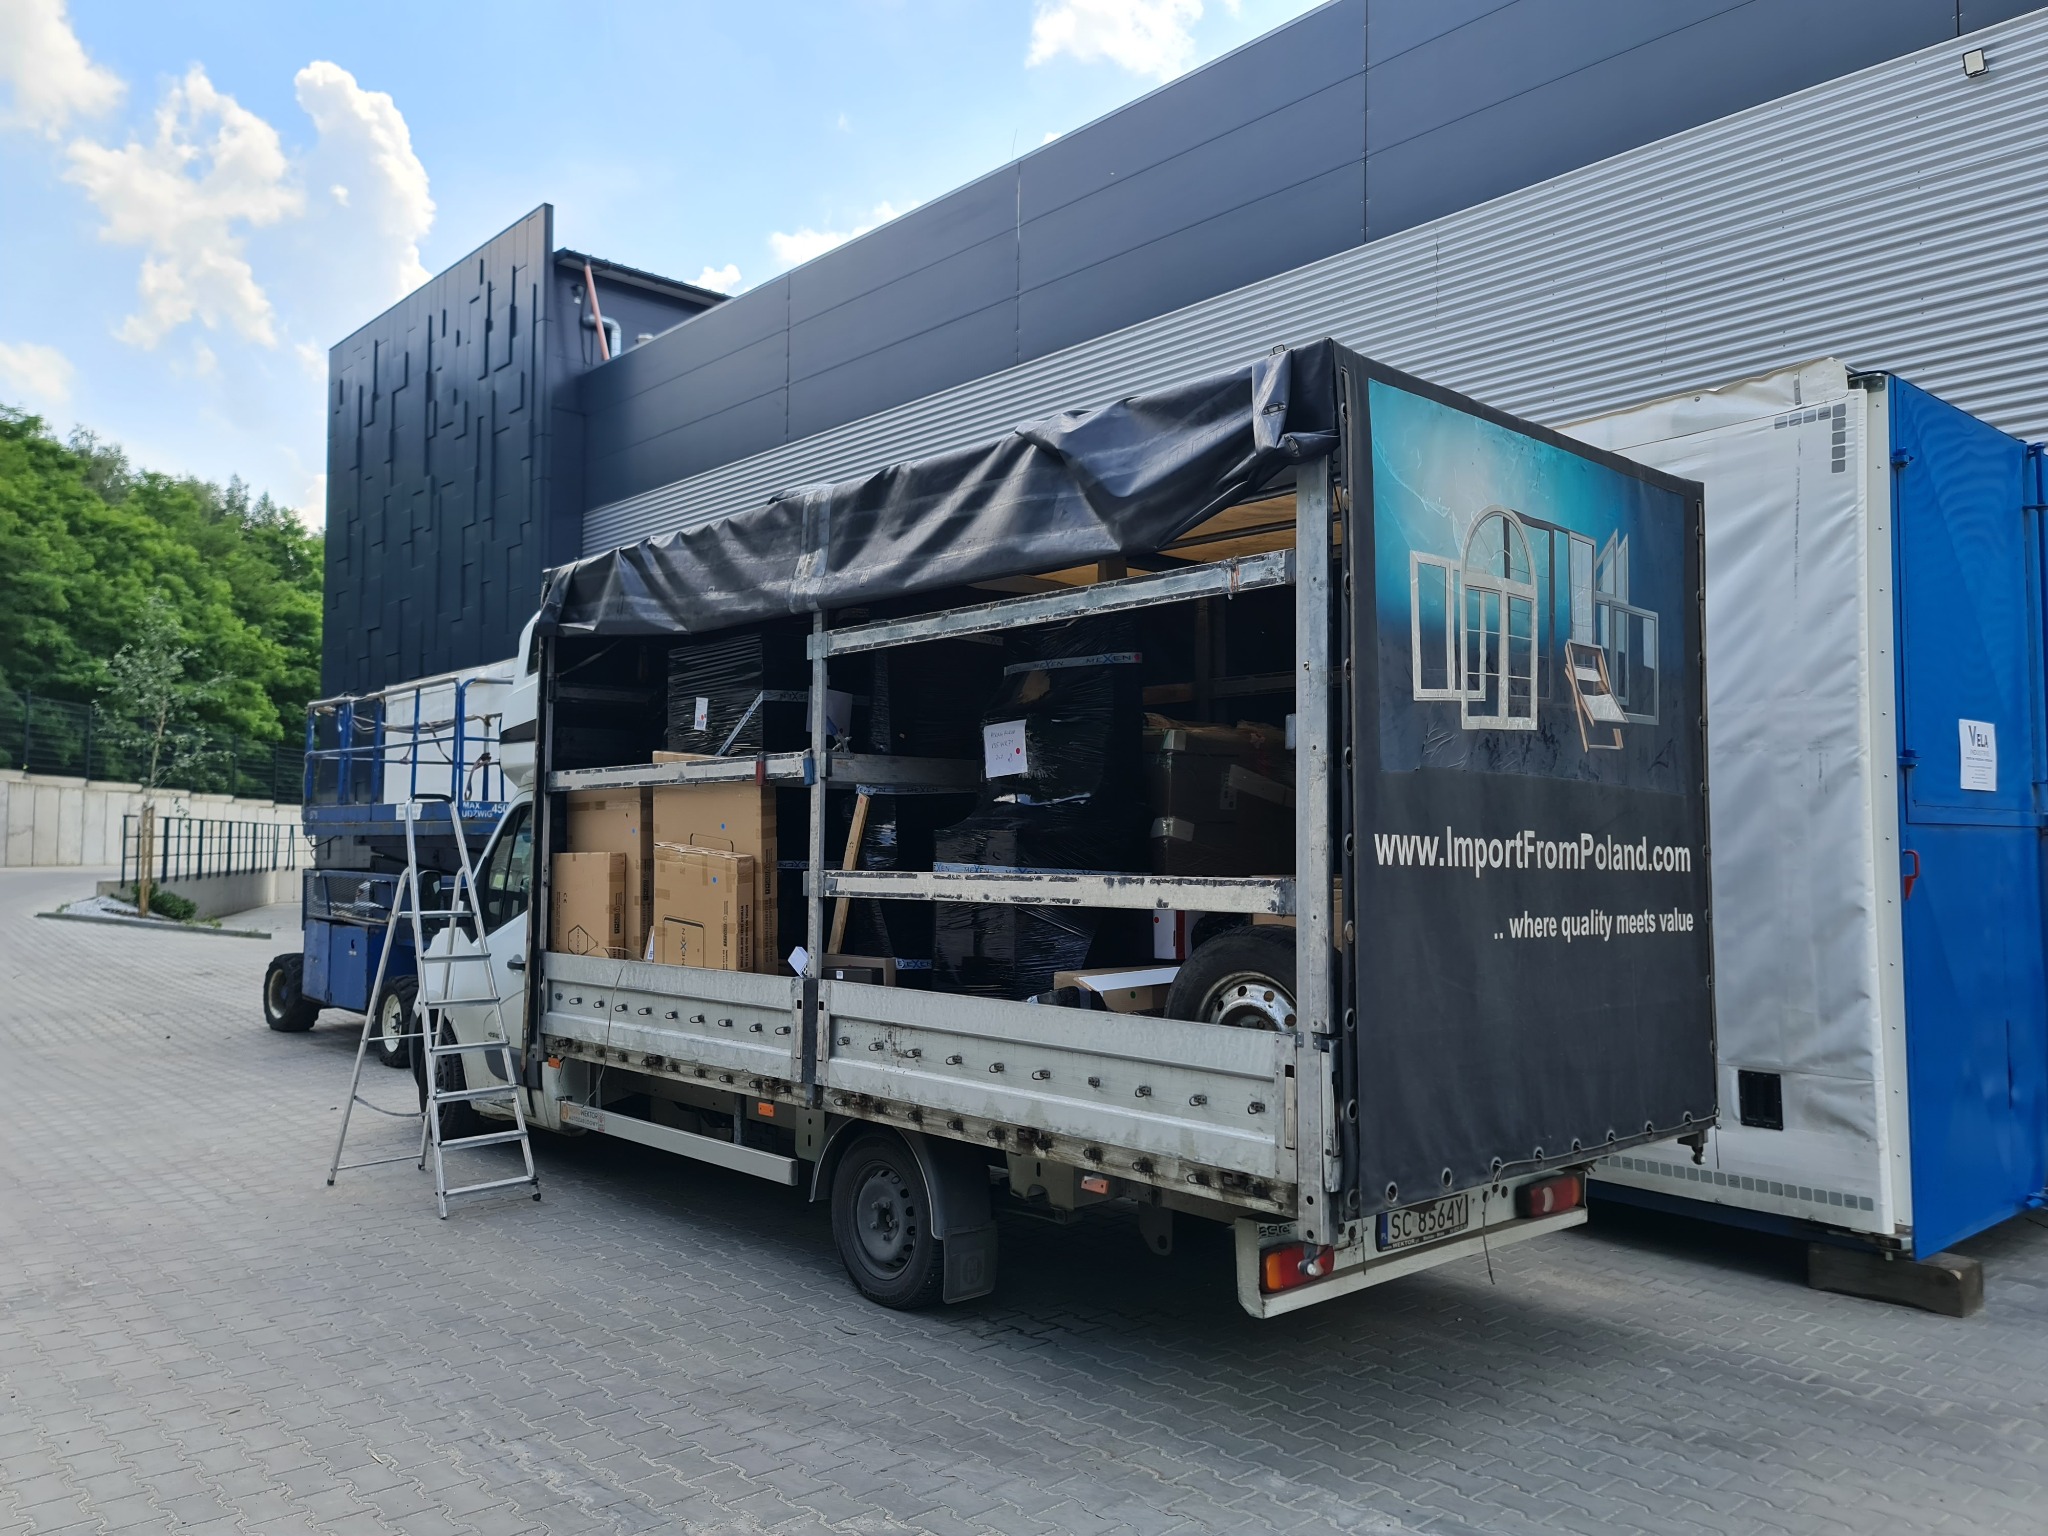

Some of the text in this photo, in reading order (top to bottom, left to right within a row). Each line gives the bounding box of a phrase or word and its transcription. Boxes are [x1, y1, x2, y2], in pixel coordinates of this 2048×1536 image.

[1087, 653, 1131, 665] MEXEN
[1968, 724, 1989, 748] VELA
[1374, 826, 1691, 878] www.ImportFromPoland.com
[1562, 909, 1612, 943] quality
[1616, 910, 1656, 935] meets
[1660, 907, 1694, 933] value
[679, 927, 688, 966] MEXEN
[1392, 1198, 1464, 1240] SC 8564Y
